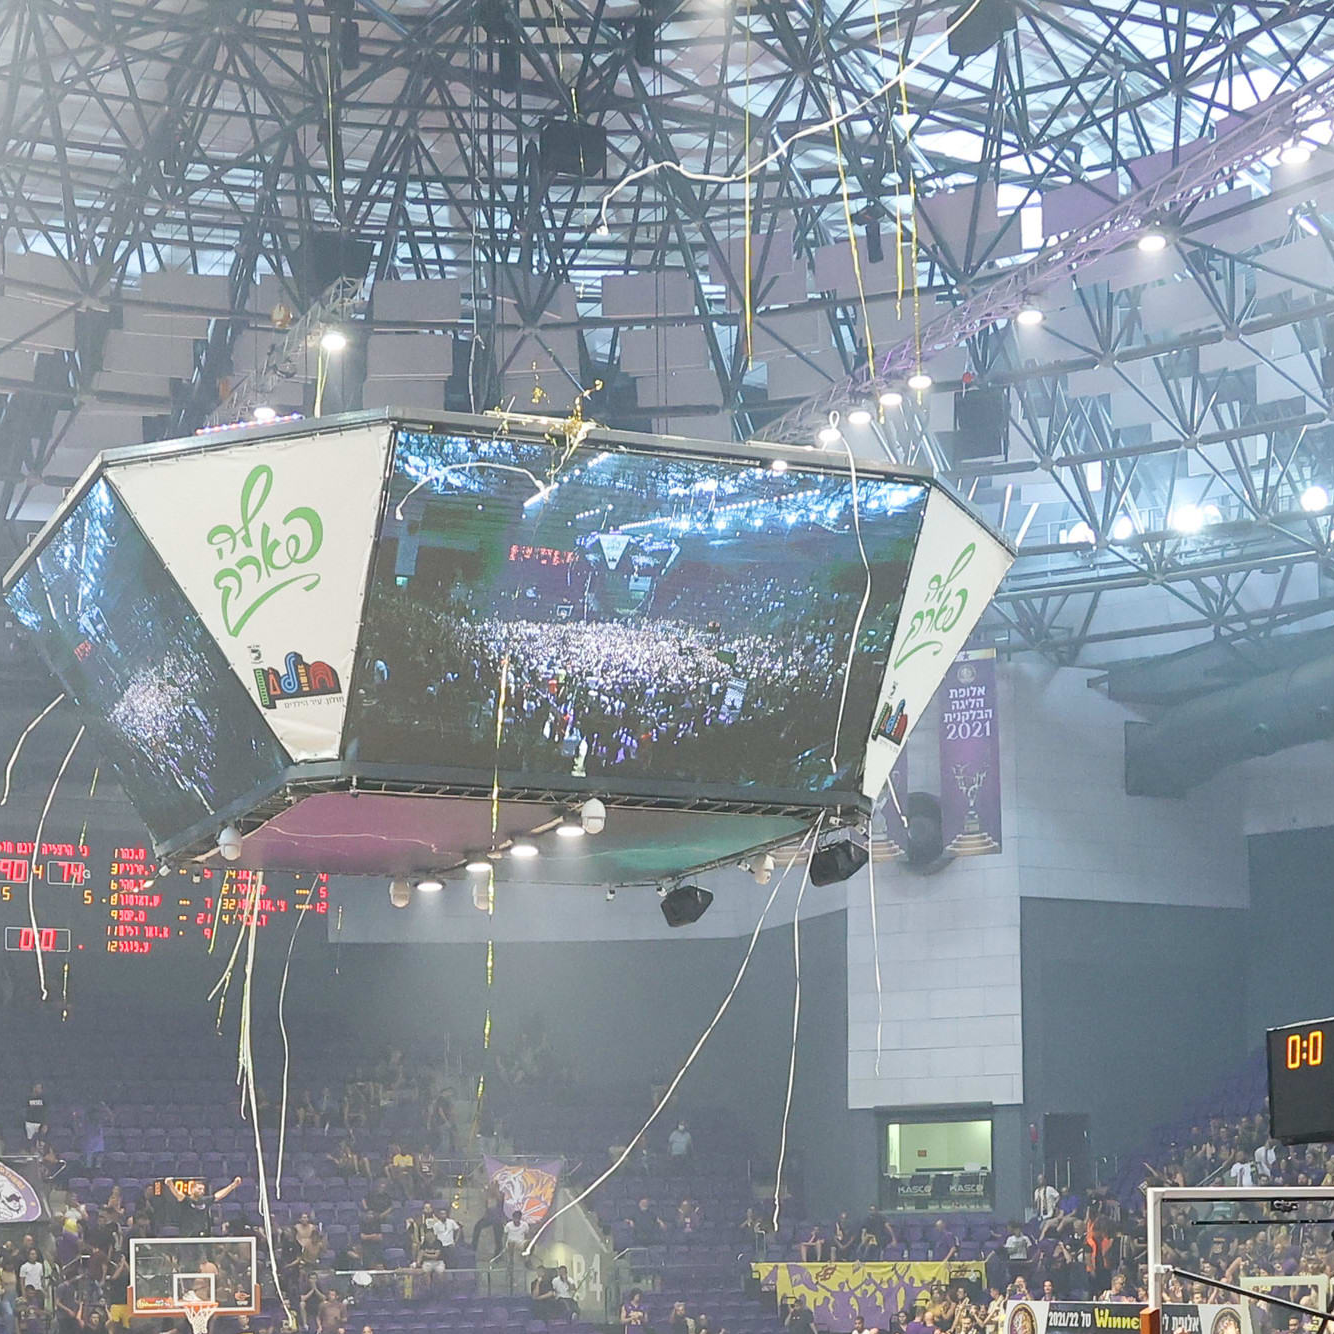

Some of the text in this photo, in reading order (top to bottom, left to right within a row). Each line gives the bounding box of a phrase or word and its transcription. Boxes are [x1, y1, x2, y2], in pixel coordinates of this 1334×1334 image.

[949, 686, 986, 699] אלופת
[951, 698, 984, 710] הליגה
[943, 709, 993, 723] הבלקנית
[946, 722, 991, 740] 2021
[58, 862, 84, 883] 74
[2, 886, 12, 900] 5
[83, 889, 93, 904] 5
[222, 899, 236, 910] 32
[107, 940, 118, 952] 12
[1286, 1030, 1323, 1069] 0:0
[897, 1184, 932, 1194] KASCO
[949, 1183, 984, 1193] KASCO
[1048, 1311, 1079, 1328] 2021/22
[1095, 1307, 1141, 1330] Winne
